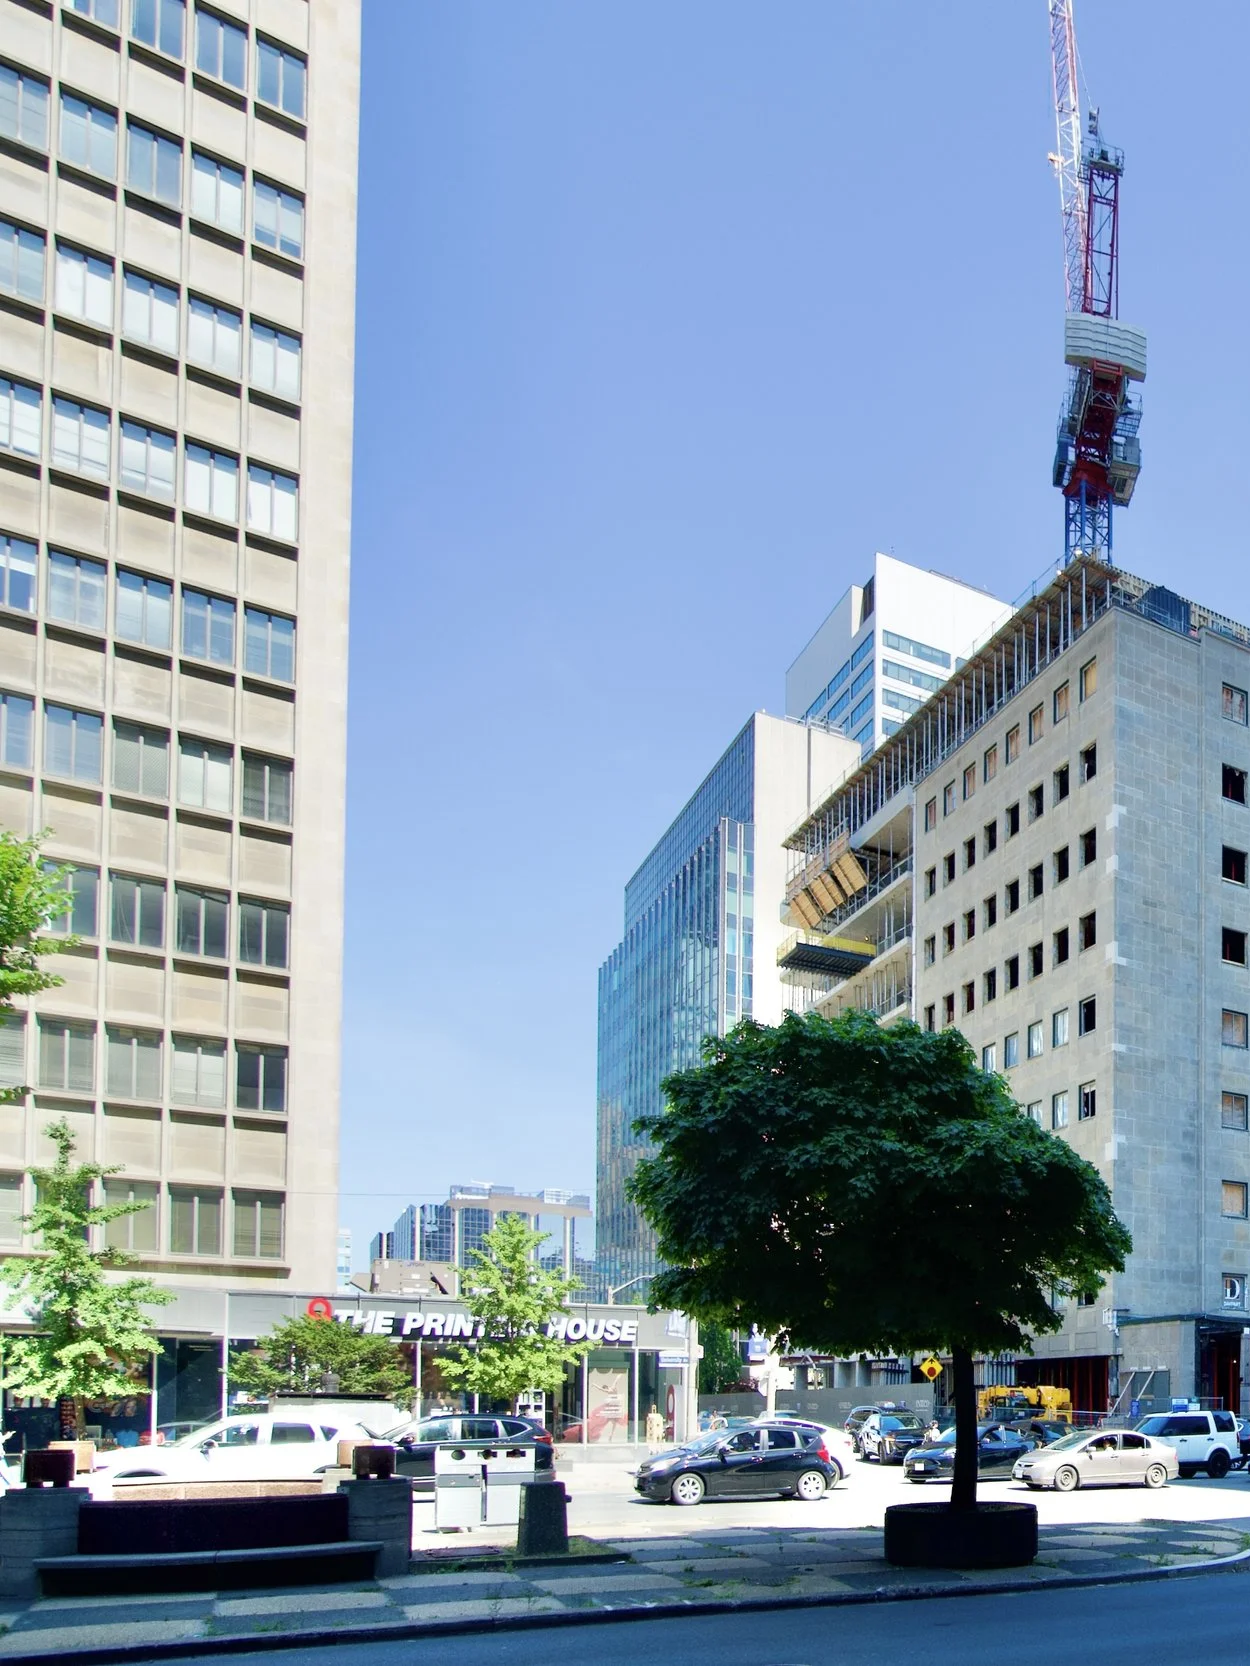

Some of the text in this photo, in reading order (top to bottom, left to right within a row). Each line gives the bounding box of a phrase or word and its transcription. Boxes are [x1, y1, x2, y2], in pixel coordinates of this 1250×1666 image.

[1224, 1278, 1241, 1300] D
[334, 1309, 396, 1334] THE
[547, 1317, 639, 1342] HOUSE
